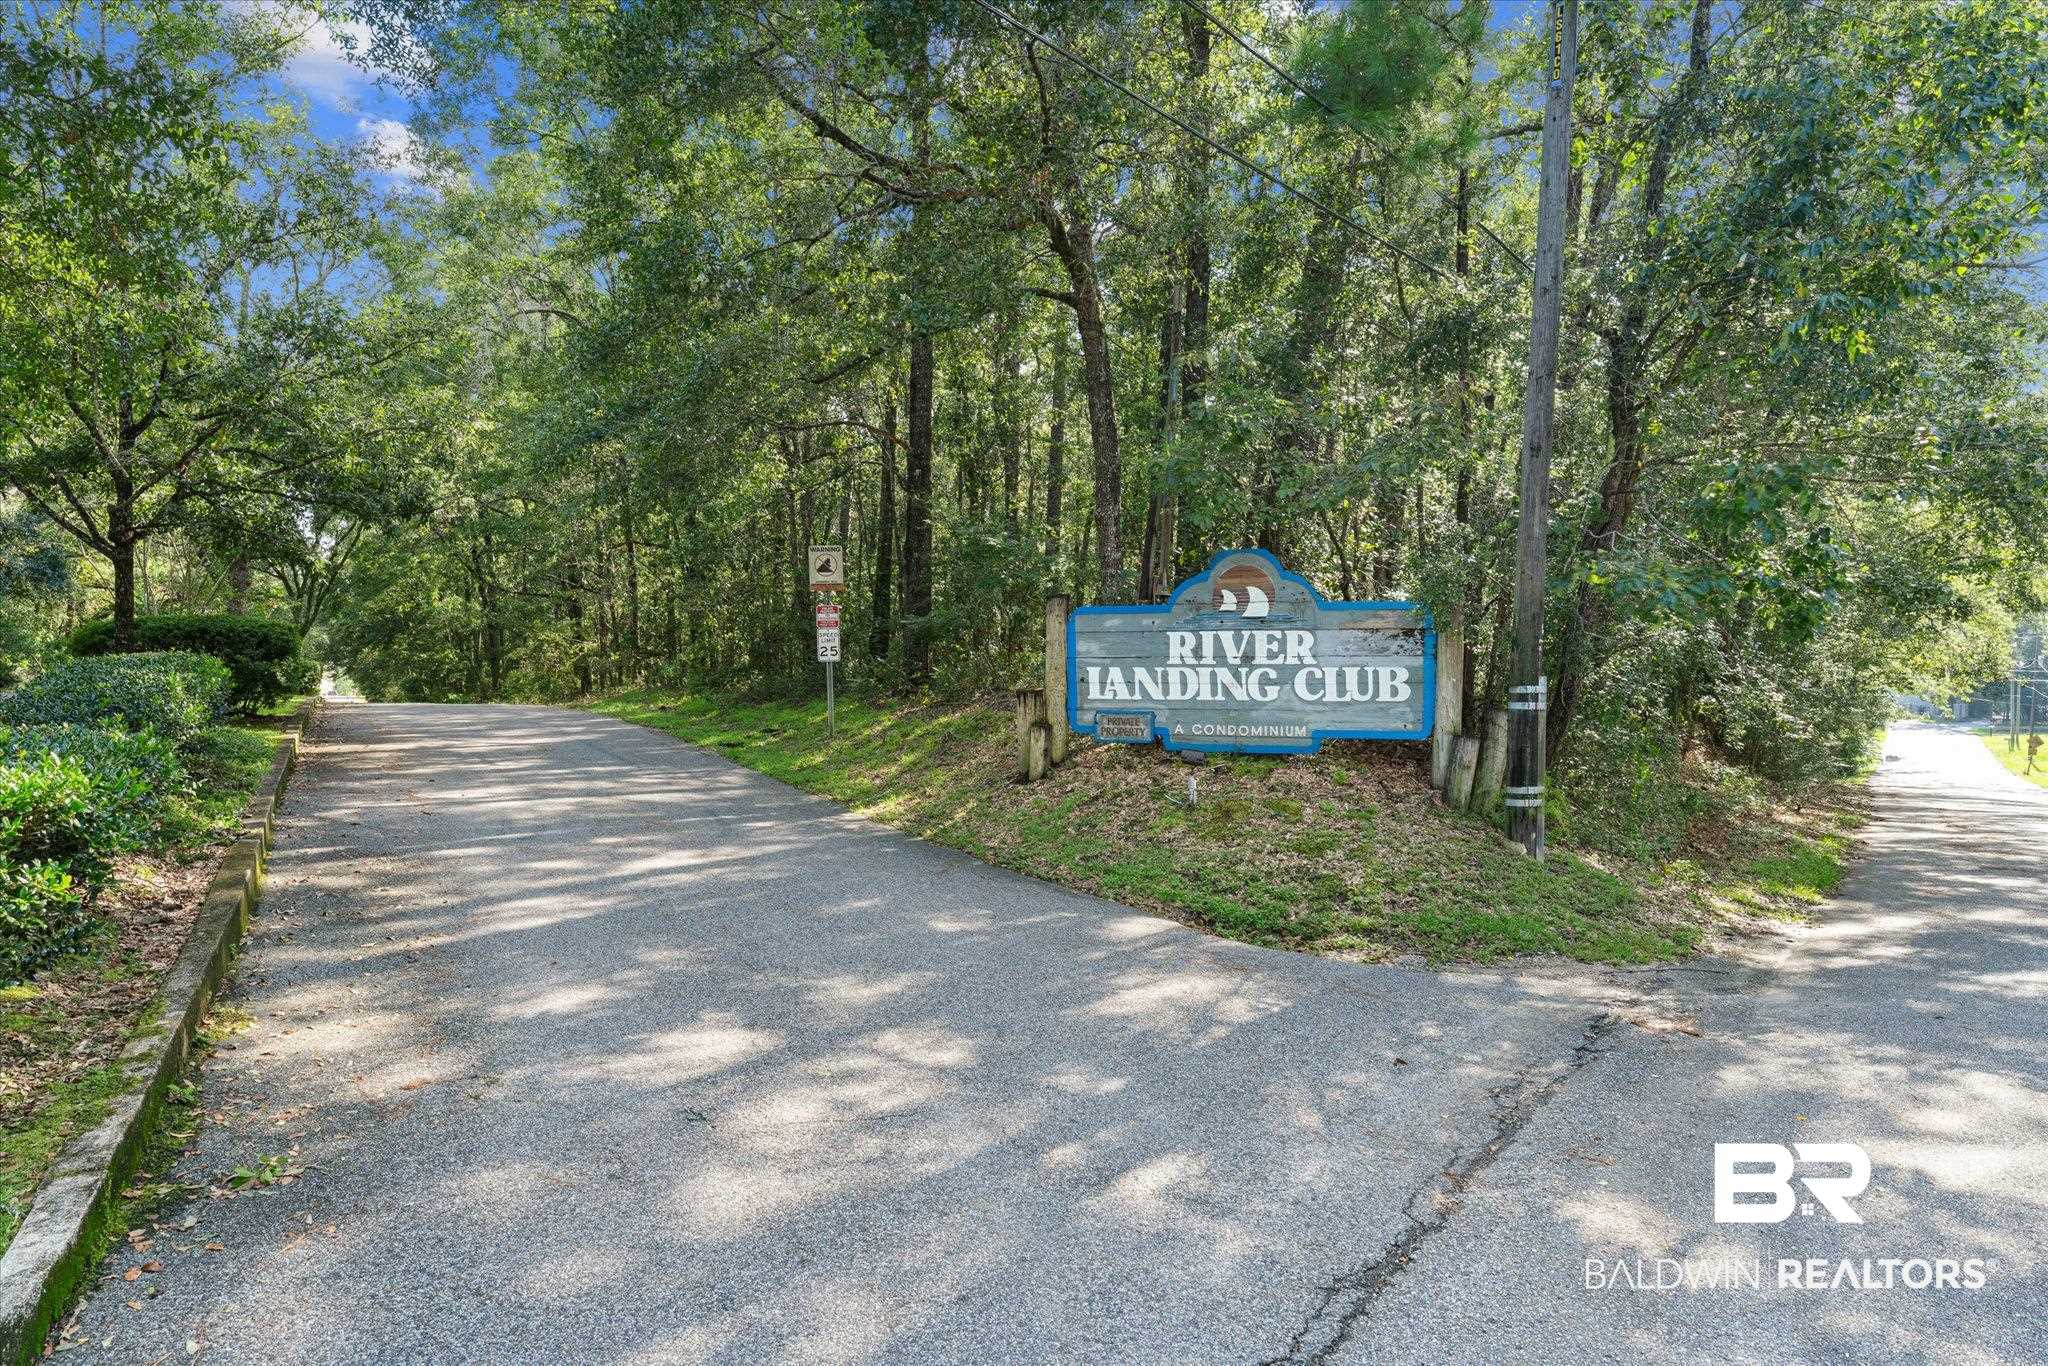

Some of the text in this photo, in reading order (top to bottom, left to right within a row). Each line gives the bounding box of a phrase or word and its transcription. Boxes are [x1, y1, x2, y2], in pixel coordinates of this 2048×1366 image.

[820, 646, 838, 657] 25
[1166, 630, 1318, 665] RIVER
[1086, 666, 1411, 702] LANDING CLUB
[1107, 717, 1140, 727] PRIVATE
[1101, 726, 1146, 737] PROPERTY
[1174, 723, 1308, 737] A CONDOMINIUM
